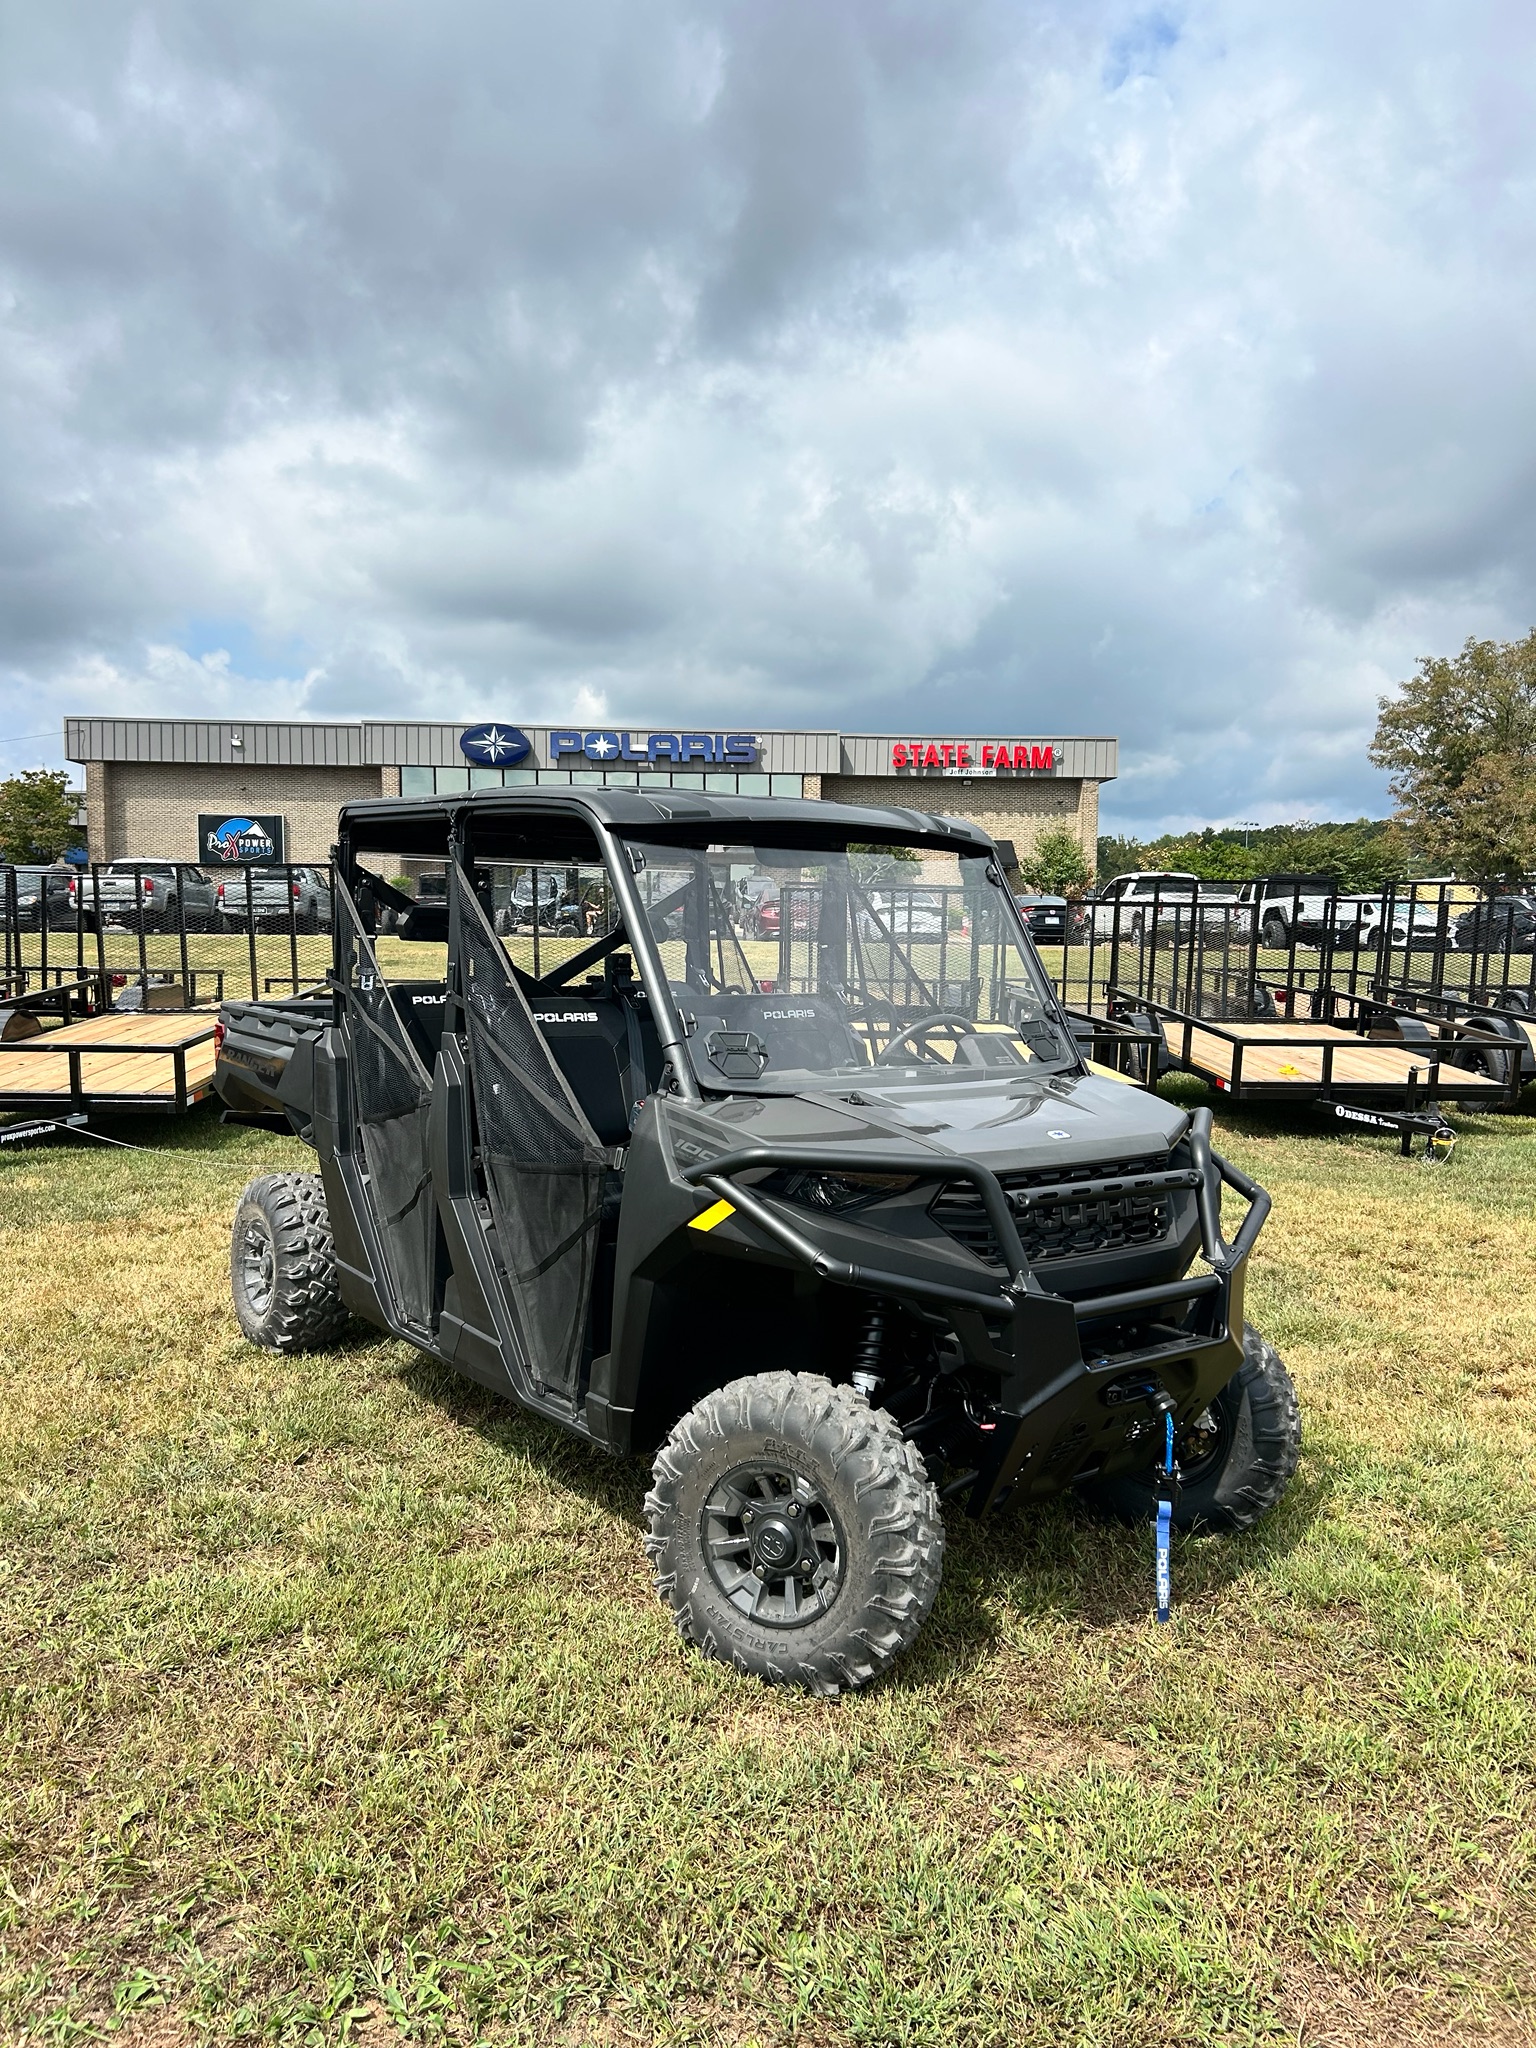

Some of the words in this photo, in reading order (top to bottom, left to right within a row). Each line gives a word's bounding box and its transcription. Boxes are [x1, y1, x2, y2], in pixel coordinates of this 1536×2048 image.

[550, 731, 759, 764] POLARIS
[892, 743, 970, 768] STATE
[981, 745, 1053, 769] FARM
[949, 768, 964, 776] Jeff
[965, 768, 994, 776] Johnson
[238, 838, 271, 848] POWER
[238, 846, 272, 854] SPORTS
[412, 995, 447, 1005] POLA
[533, 1012, 599, 1023] POLARIS
[763, 1009, 816, 1020] POLARIS
[226, 1049, 275, 1077] RANGER
[1335, 1105, 1378, 1126] ODESSA
[1157, 1548, 1169, 1610] POLARIS
[705, 1604, 789, 1654] CARLSTAR
